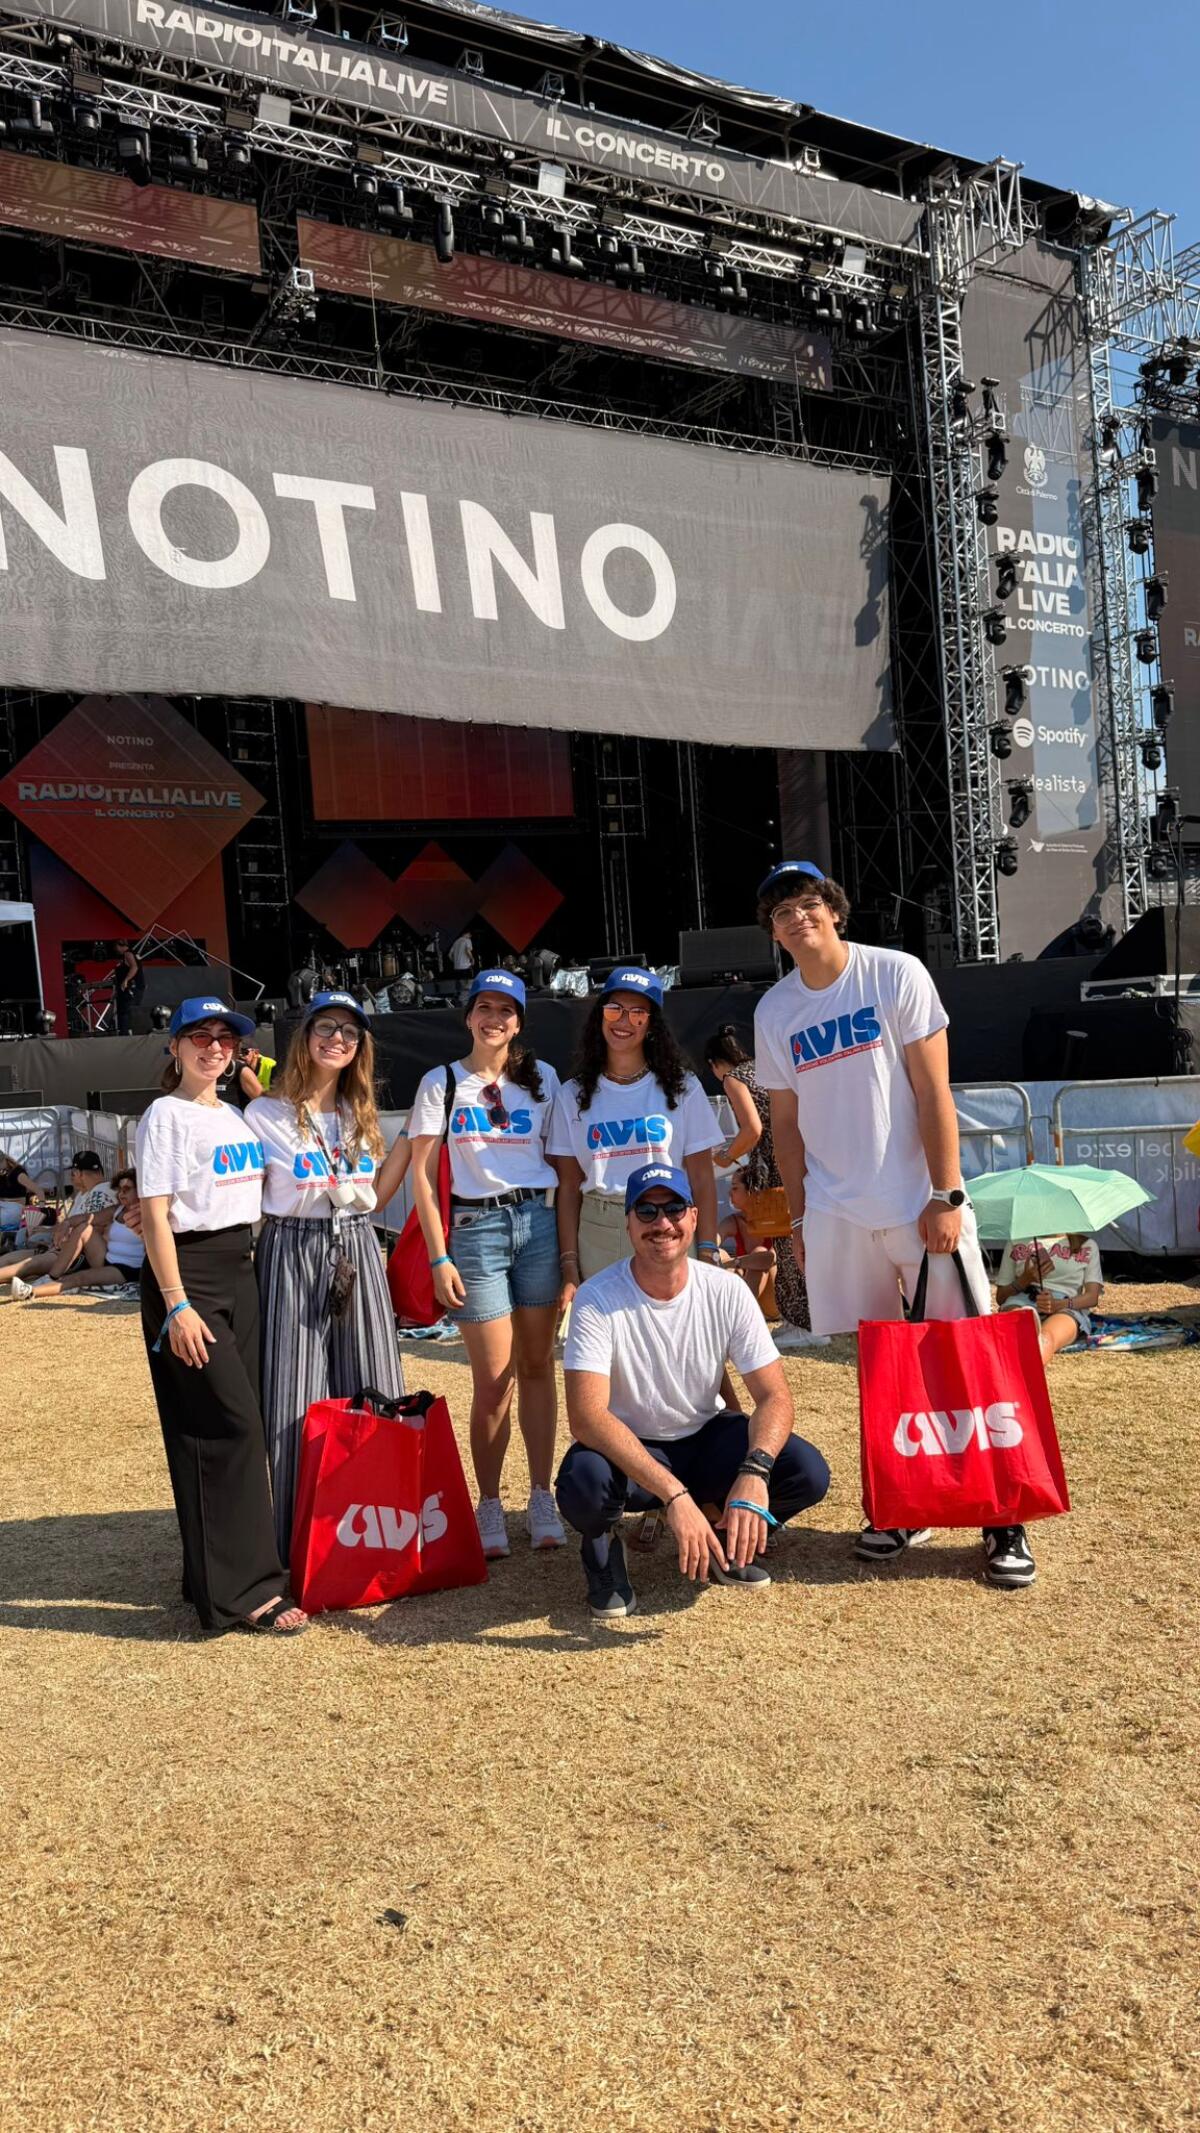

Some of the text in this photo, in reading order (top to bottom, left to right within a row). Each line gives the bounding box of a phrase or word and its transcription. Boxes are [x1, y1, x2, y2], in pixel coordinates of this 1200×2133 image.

[546, 117, 726, 183] IL CONCERTO
[996, 526, 1081, 560] RADIO
[1017, 559, 1085, 591] ALIA
[1017, 587, 1072, 616] LIVE
[1017, 617, 1085, 638] CONCERTO
[1021, 664, 1090, 692] OTINO
[106, 735, 154, 746] NOTINO
[1037, 725, 1086, 748] Spotify
[1023, 773, 1087, 793] dealista
[95, 808, 175, 819] IL CONCERTO
[789, 1006, 882, 1068] AVIS
[451, 1106, 533, 1134] AVS
[587, 1116, 667, 1150] AVIS
[893, 1401, 1024, 1457] AVIS
